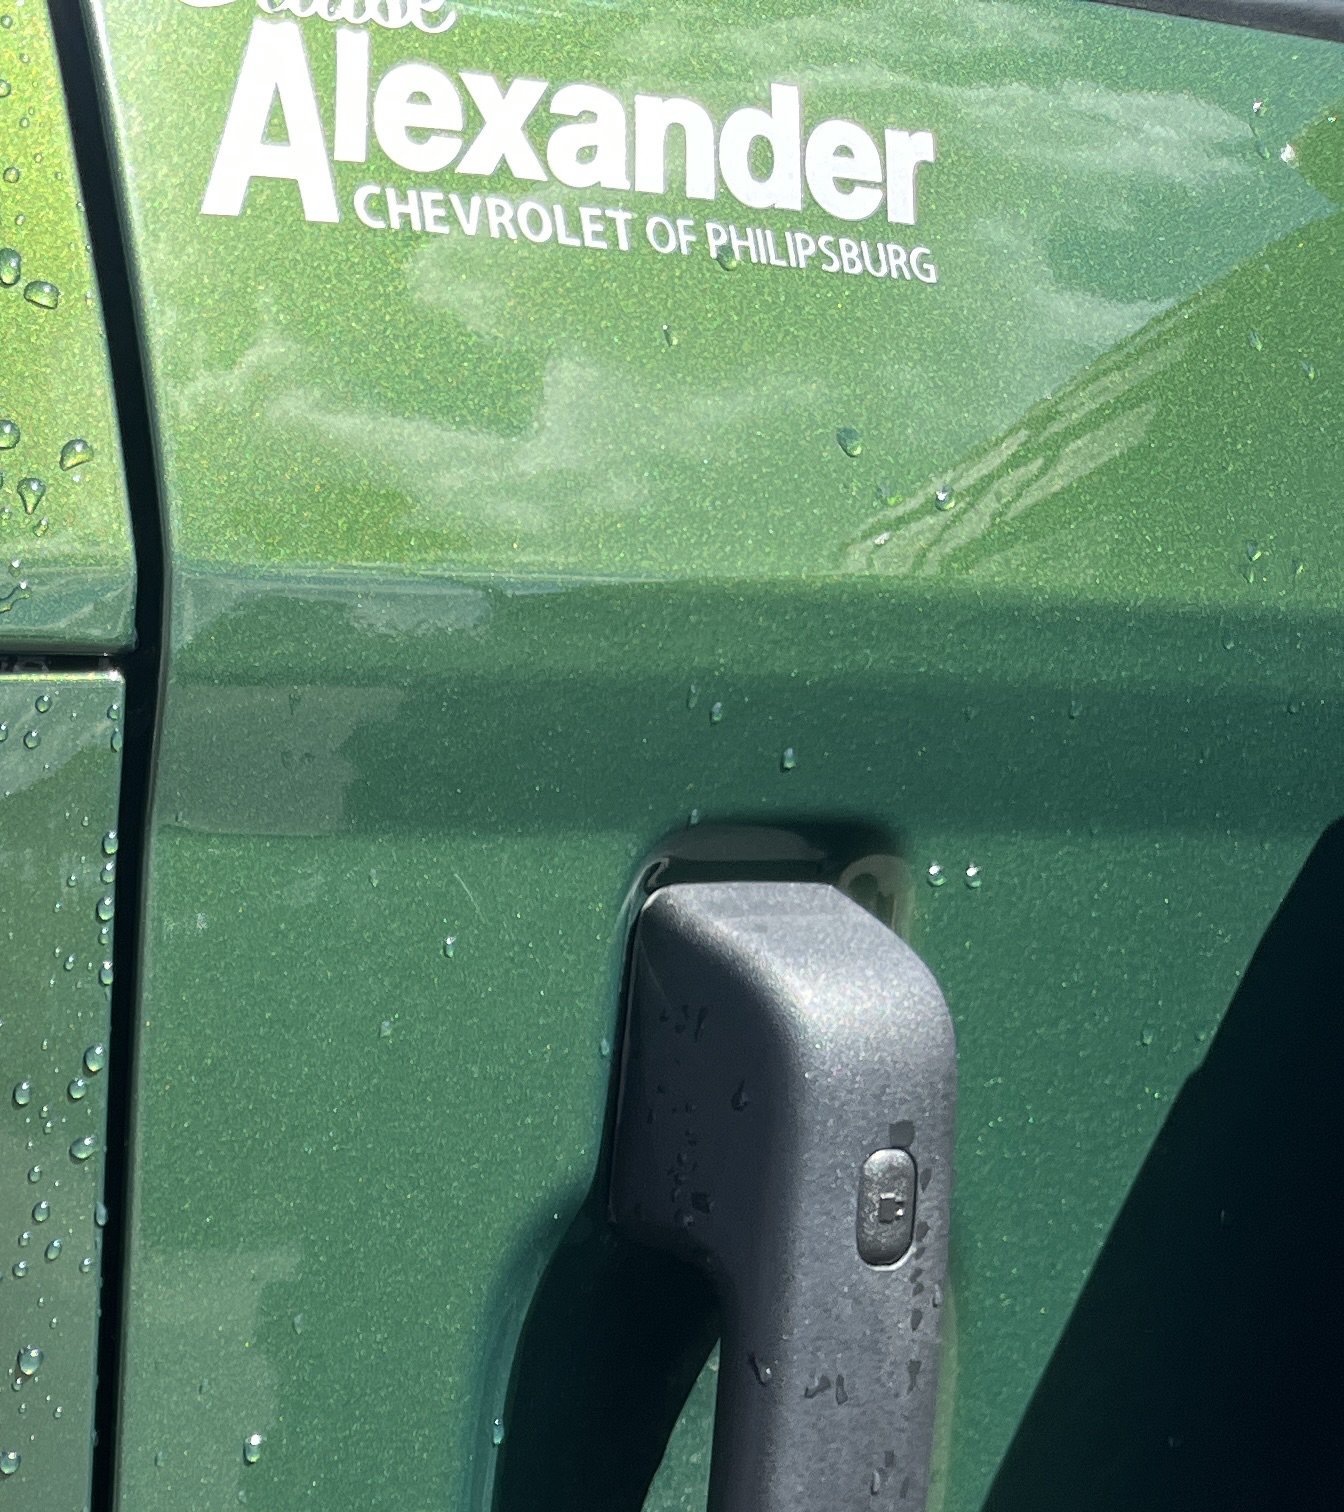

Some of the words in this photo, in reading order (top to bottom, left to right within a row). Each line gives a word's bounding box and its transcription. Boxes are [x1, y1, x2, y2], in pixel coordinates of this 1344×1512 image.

[199, 17, 936, 226] Alexander
[352, 182, 635, 254] CHEVROLET
[645, 213, 698, 256] OF
[704, 219, 939, 285] PHILIPSBURG
